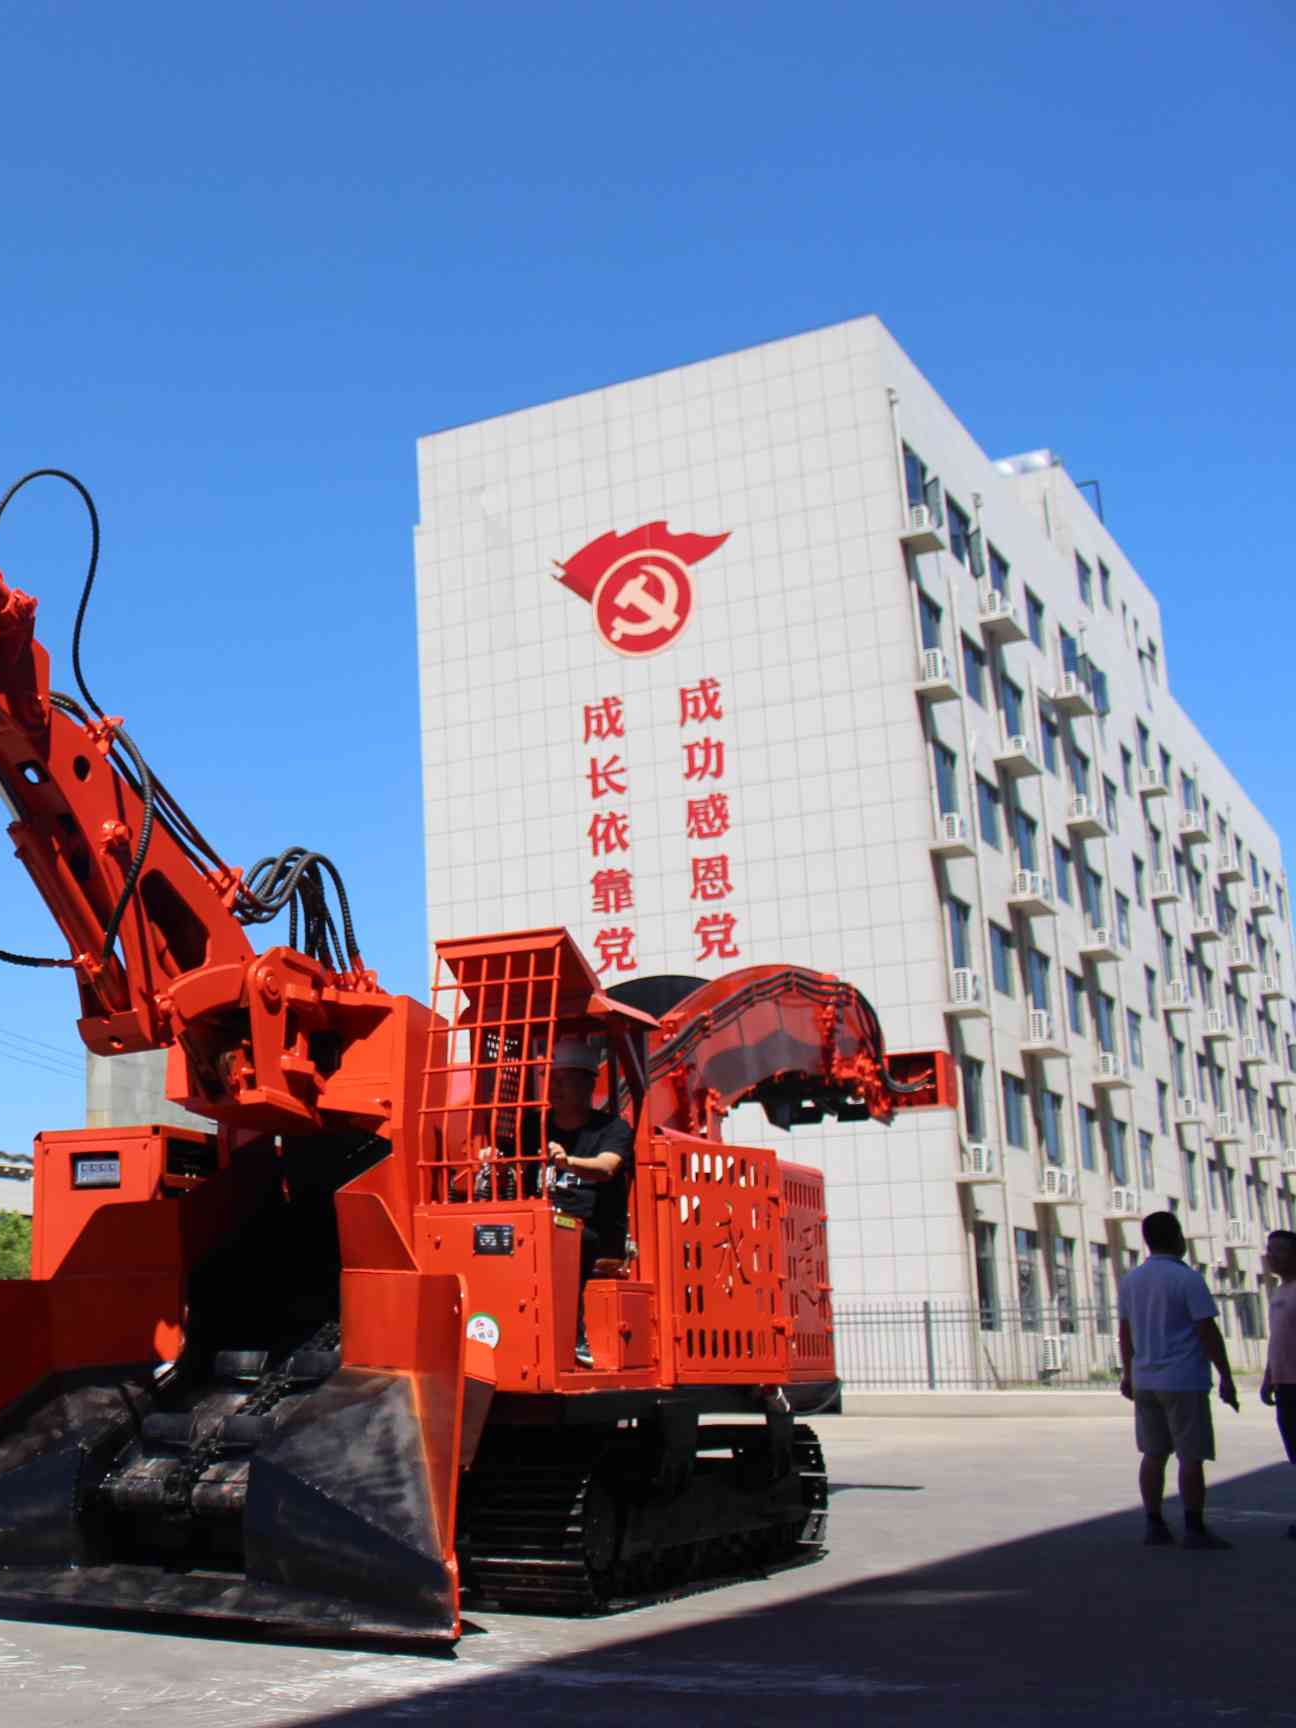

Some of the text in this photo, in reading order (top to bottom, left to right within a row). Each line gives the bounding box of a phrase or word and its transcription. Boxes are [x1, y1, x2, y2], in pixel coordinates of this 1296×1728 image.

[582, 696, 638, 974] 成长依靠党
[679, 677, 740, 961] 成功感恩党
